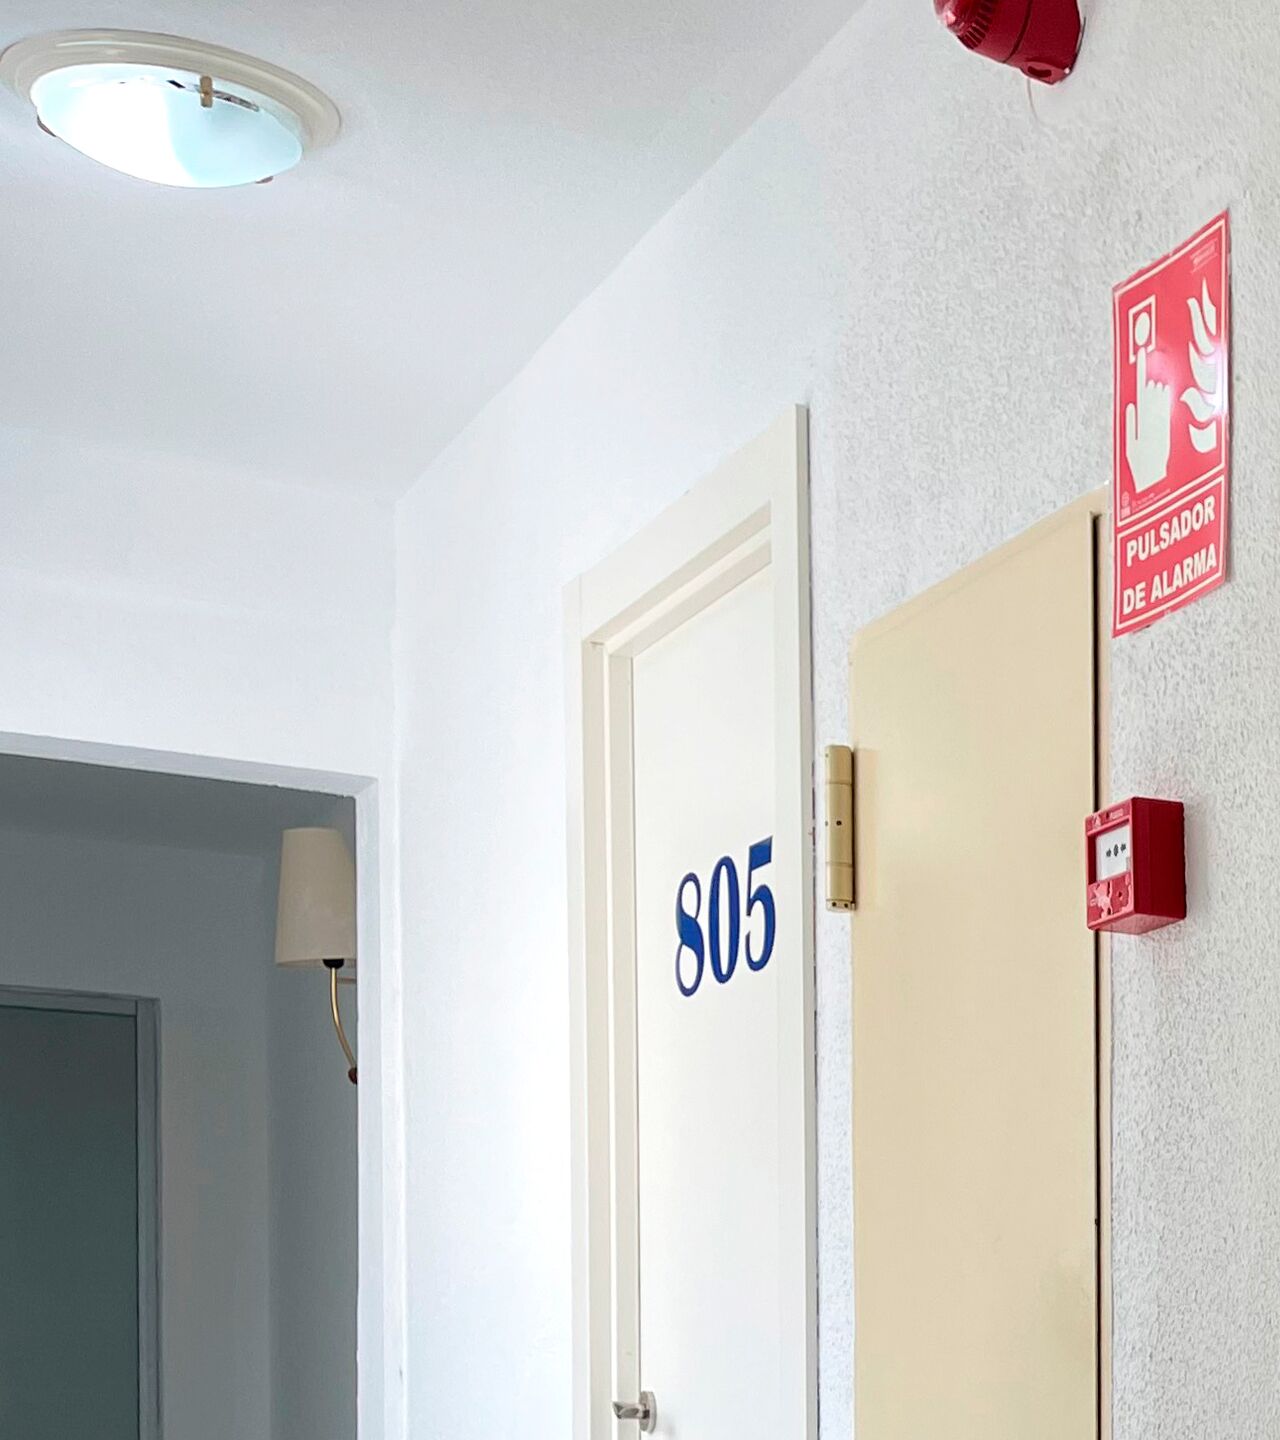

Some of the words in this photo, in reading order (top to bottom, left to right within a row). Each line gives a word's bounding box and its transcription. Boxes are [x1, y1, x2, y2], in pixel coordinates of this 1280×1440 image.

[1126, 495, 1215, 567] PULSADOR
[1123, 582, 1146, 615] DE
[1150, 543, 1217, 603] ALARMA
[675, 835, 776, 997] 805
